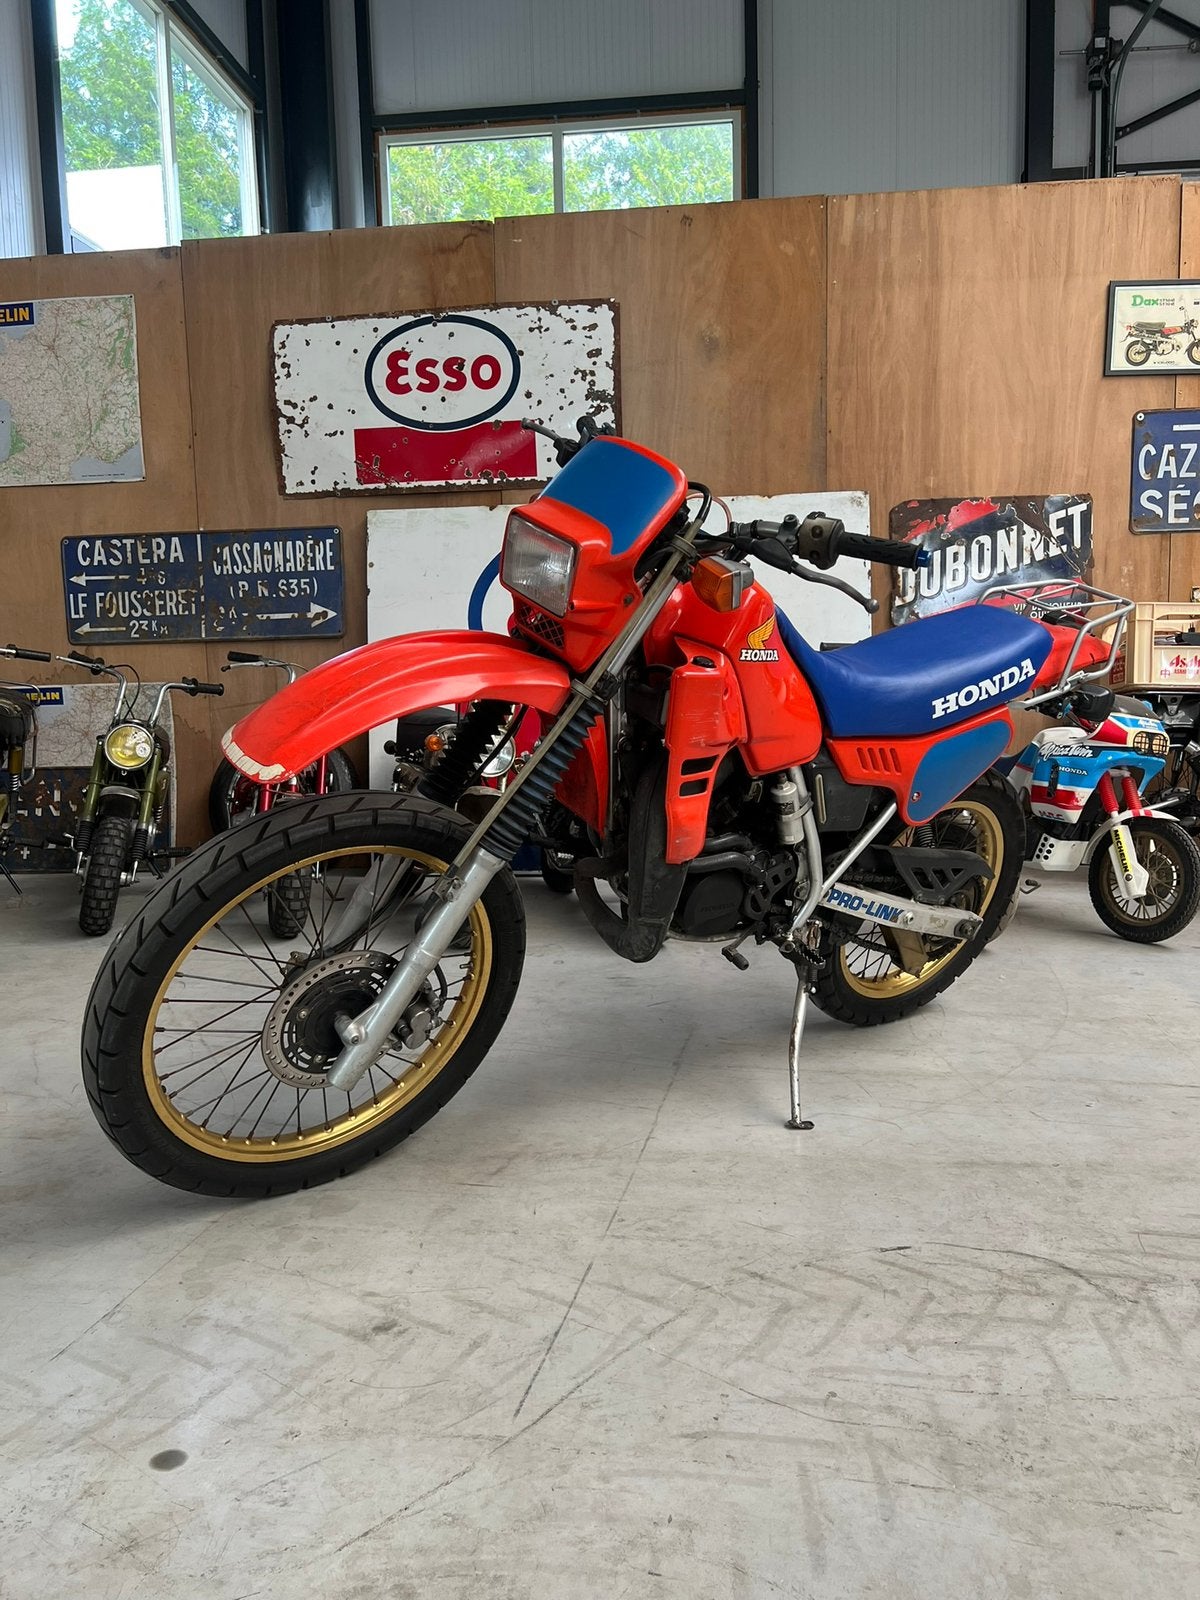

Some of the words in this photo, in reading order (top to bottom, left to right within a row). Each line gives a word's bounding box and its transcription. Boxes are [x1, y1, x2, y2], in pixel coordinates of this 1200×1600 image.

[1131, 294, 1159, 307] Dax
[1138, 443, 1198, 480] CAZ
[1140, 484, 1200, 524] SÉ
[740, 649, 779, 661] HONDA
[931, 658, 1036, 719] HONDA
[1058, 766, 1088, 776] HONDA
[1113, 829, 1130, 873] MICHELIN
[826, 888, 905, 923] PRO-LINK
